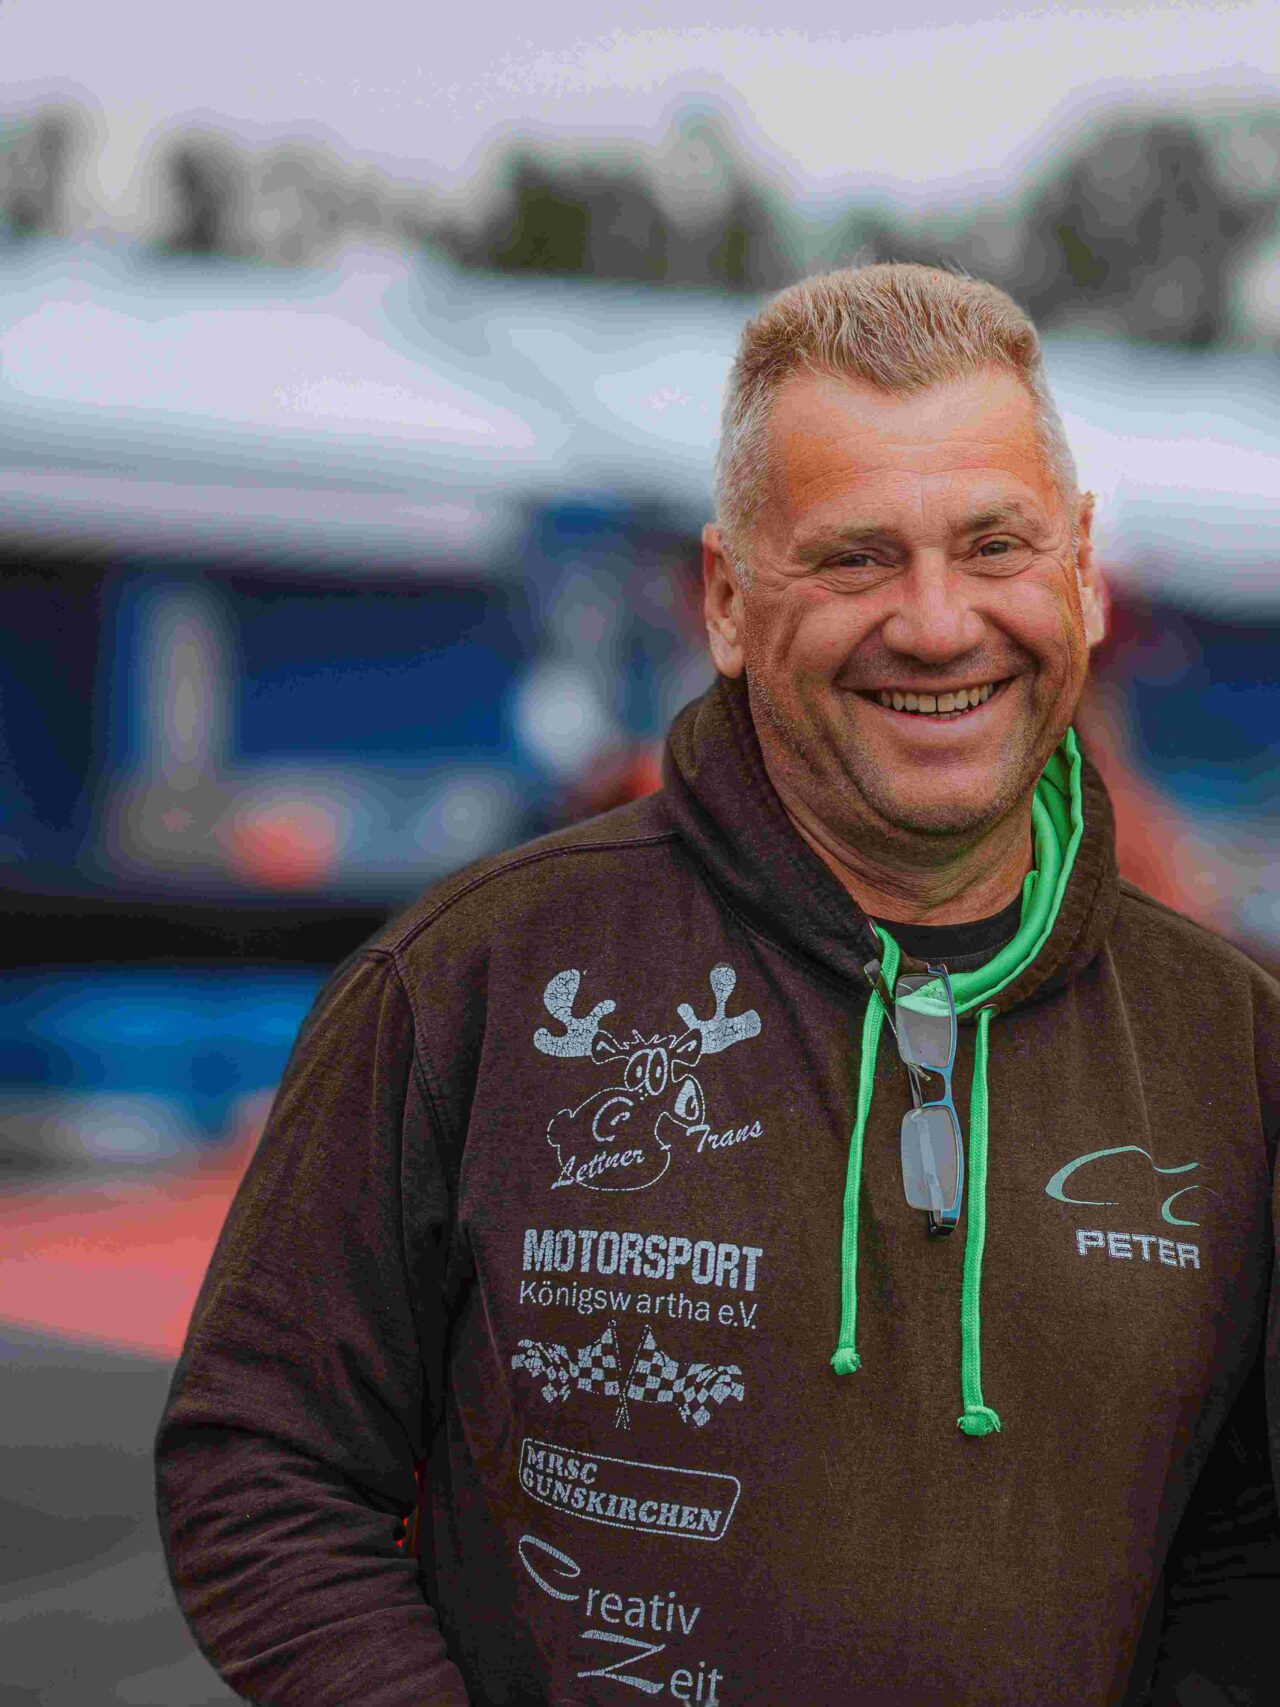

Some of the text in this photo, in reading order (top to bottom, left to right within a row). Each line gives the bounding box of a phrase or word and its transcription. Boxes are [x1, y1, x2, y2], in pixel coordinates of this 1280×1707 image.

[551, 1120, 763, 1189] Lettner Trans
[522, 1228, 763, 1291] MOTORSPORT
[1075, 1228, 1202, 1269] PETER
[519, 1280, 710, 1322] Königswartha
[526, 1445, 598, 1485] MRSC
[522, 1467, 723, 1532] GUNSKIRCHEN
[518, 1534, 701, 1634] Creativ
[577, 1629, 724, 1701] Zeit
